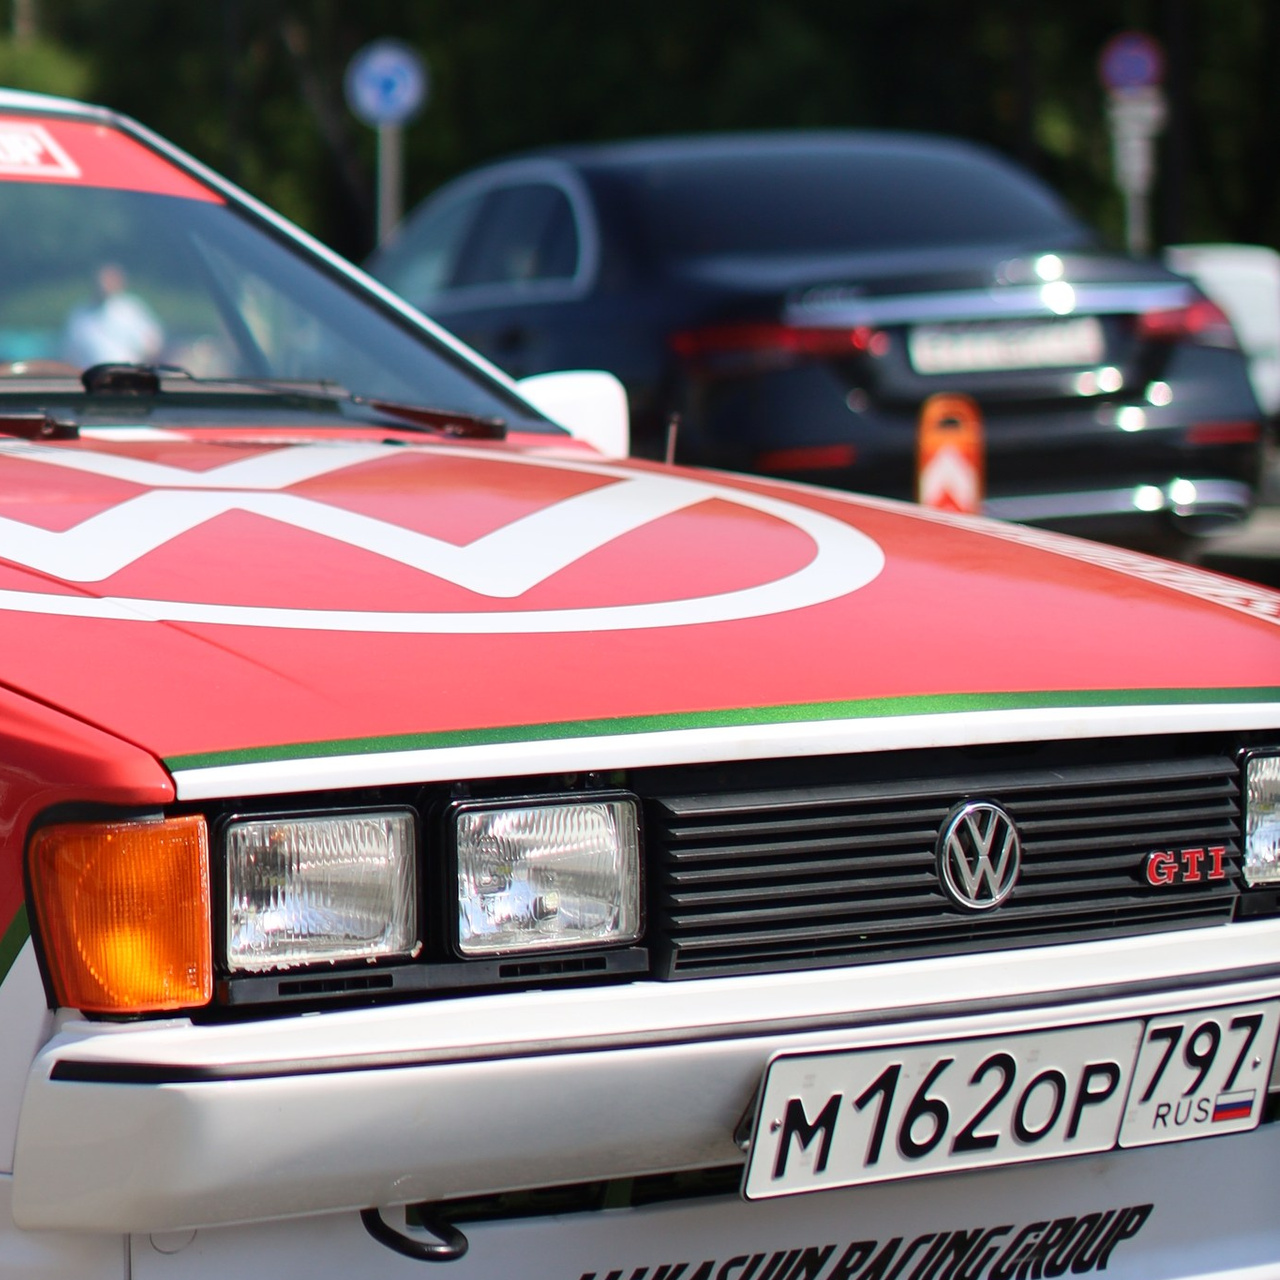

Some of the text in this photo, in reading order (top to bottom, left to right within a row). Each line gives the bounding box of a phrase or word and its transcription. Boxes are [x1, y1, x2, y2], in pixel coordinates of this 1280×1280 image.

[945, 806, 1018, 906] VW
[1146, 846, 1226, 886] GTI
[1138, 1013, 1264, 1105] 797
[1152, 1097, 1211, 1129] RUS
[988, 1203, 1155, 1280] GROUP
